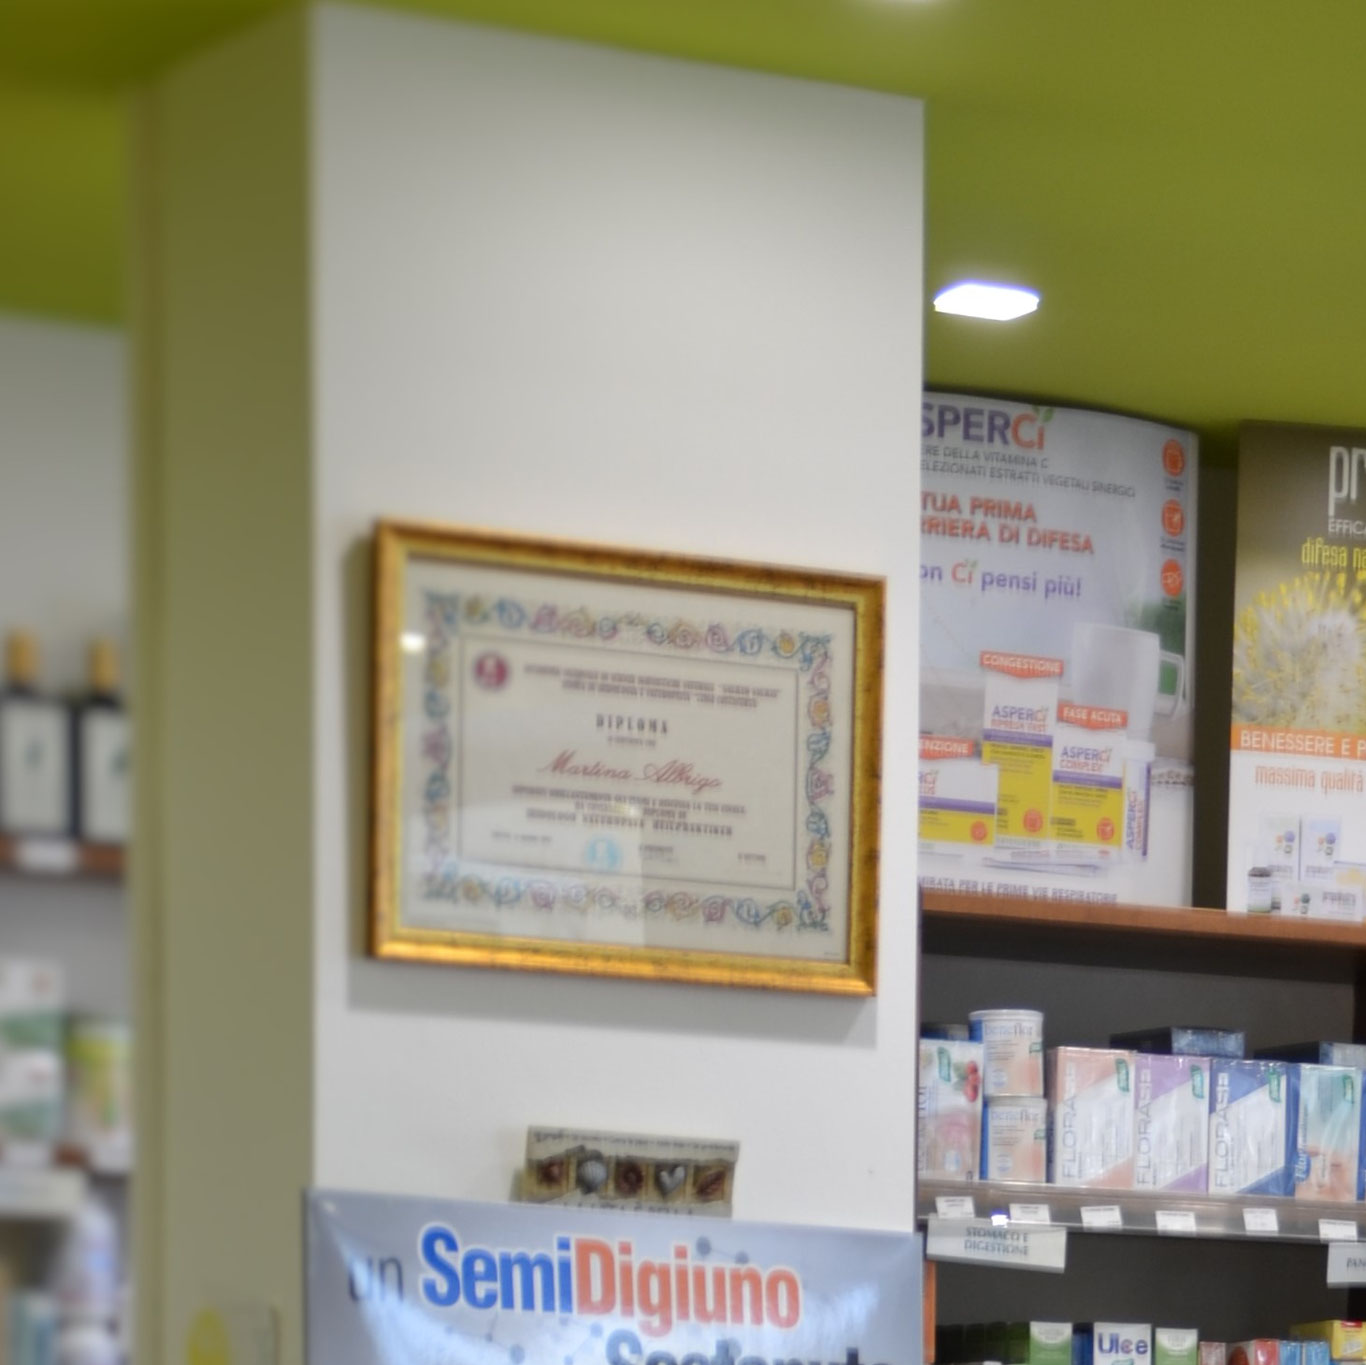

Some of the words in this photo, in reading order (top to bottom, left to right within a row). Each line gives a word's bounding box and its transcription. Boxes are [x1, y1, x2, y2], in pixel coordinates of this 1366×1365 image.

[921, 402, 1046, 450] SPERCi
[921, 460, 986, 477] ELEZIONATI
[970, 496, 1038, 523] PRIMA
[998, 525, 1020, 545] DI
[1027, 527, 1095, 555] DIFESA
[1301, 536, 1348, 567] difesa
[981, 570, 1037, 592] pensi
[1240, 730, 1335, 756] BENESSERE
[1341, 738, 1351, 756] E
